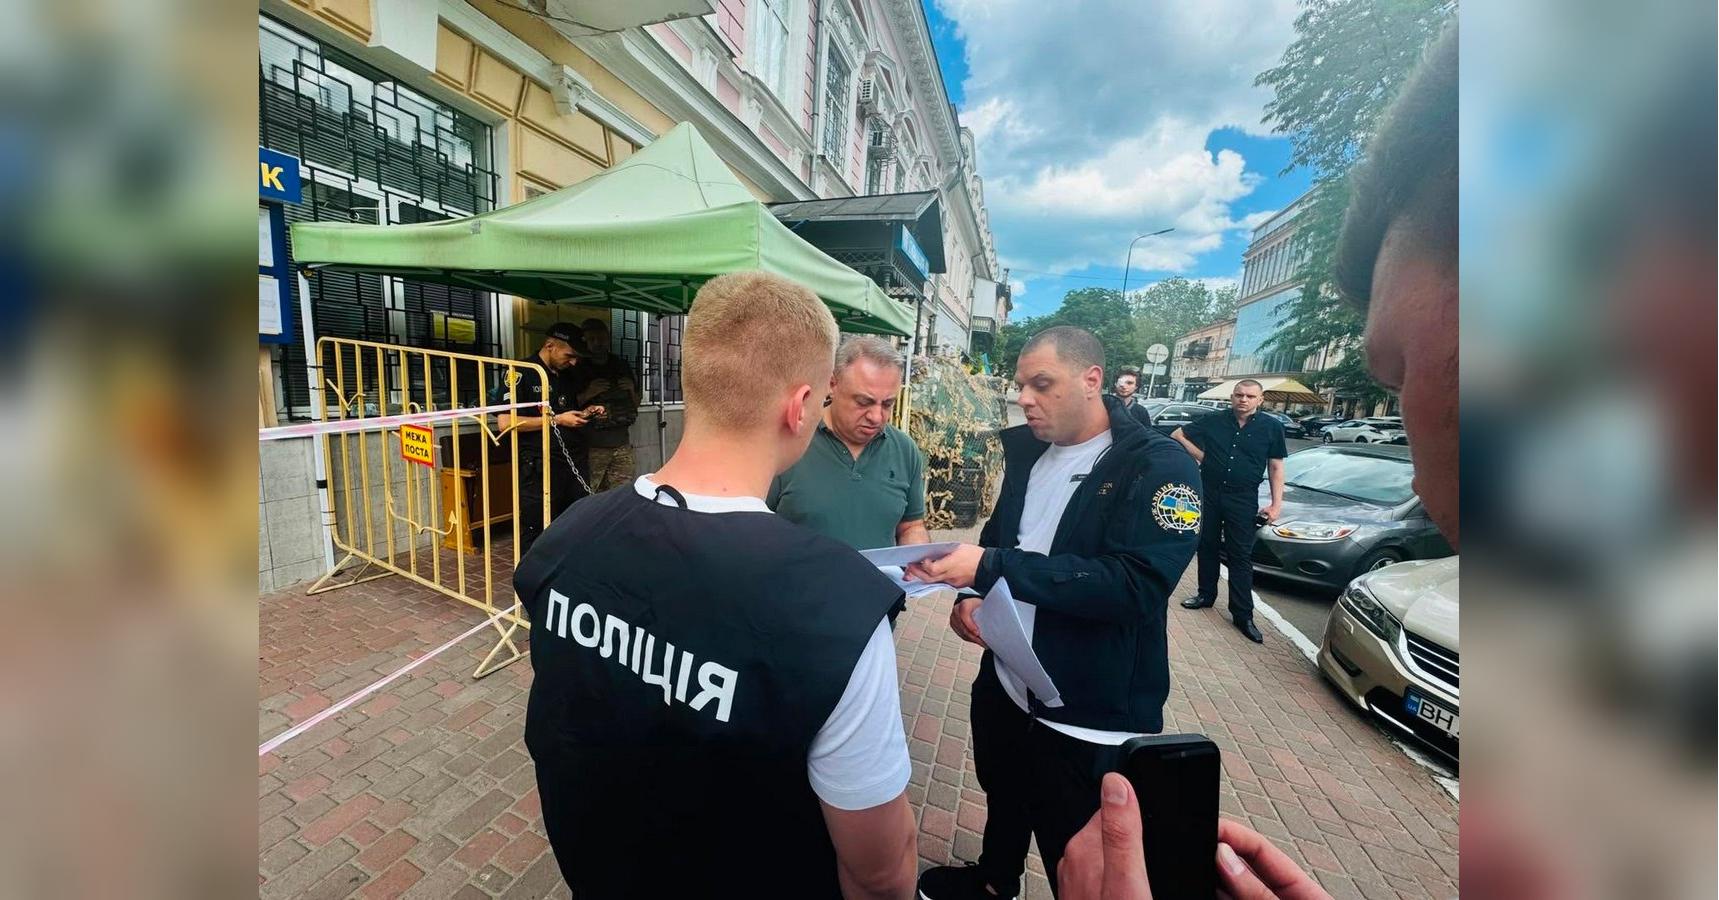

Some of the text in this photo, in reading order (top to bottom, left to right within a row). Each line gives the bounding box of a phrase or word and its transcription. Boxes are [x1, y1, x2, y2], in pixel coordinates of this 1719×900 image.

[405, 431, 427, 443] МЕЖА
[405, 444, 429, 458] ПОСТА
[546, 588, 739, 723] ПОЛІЦІЯ
